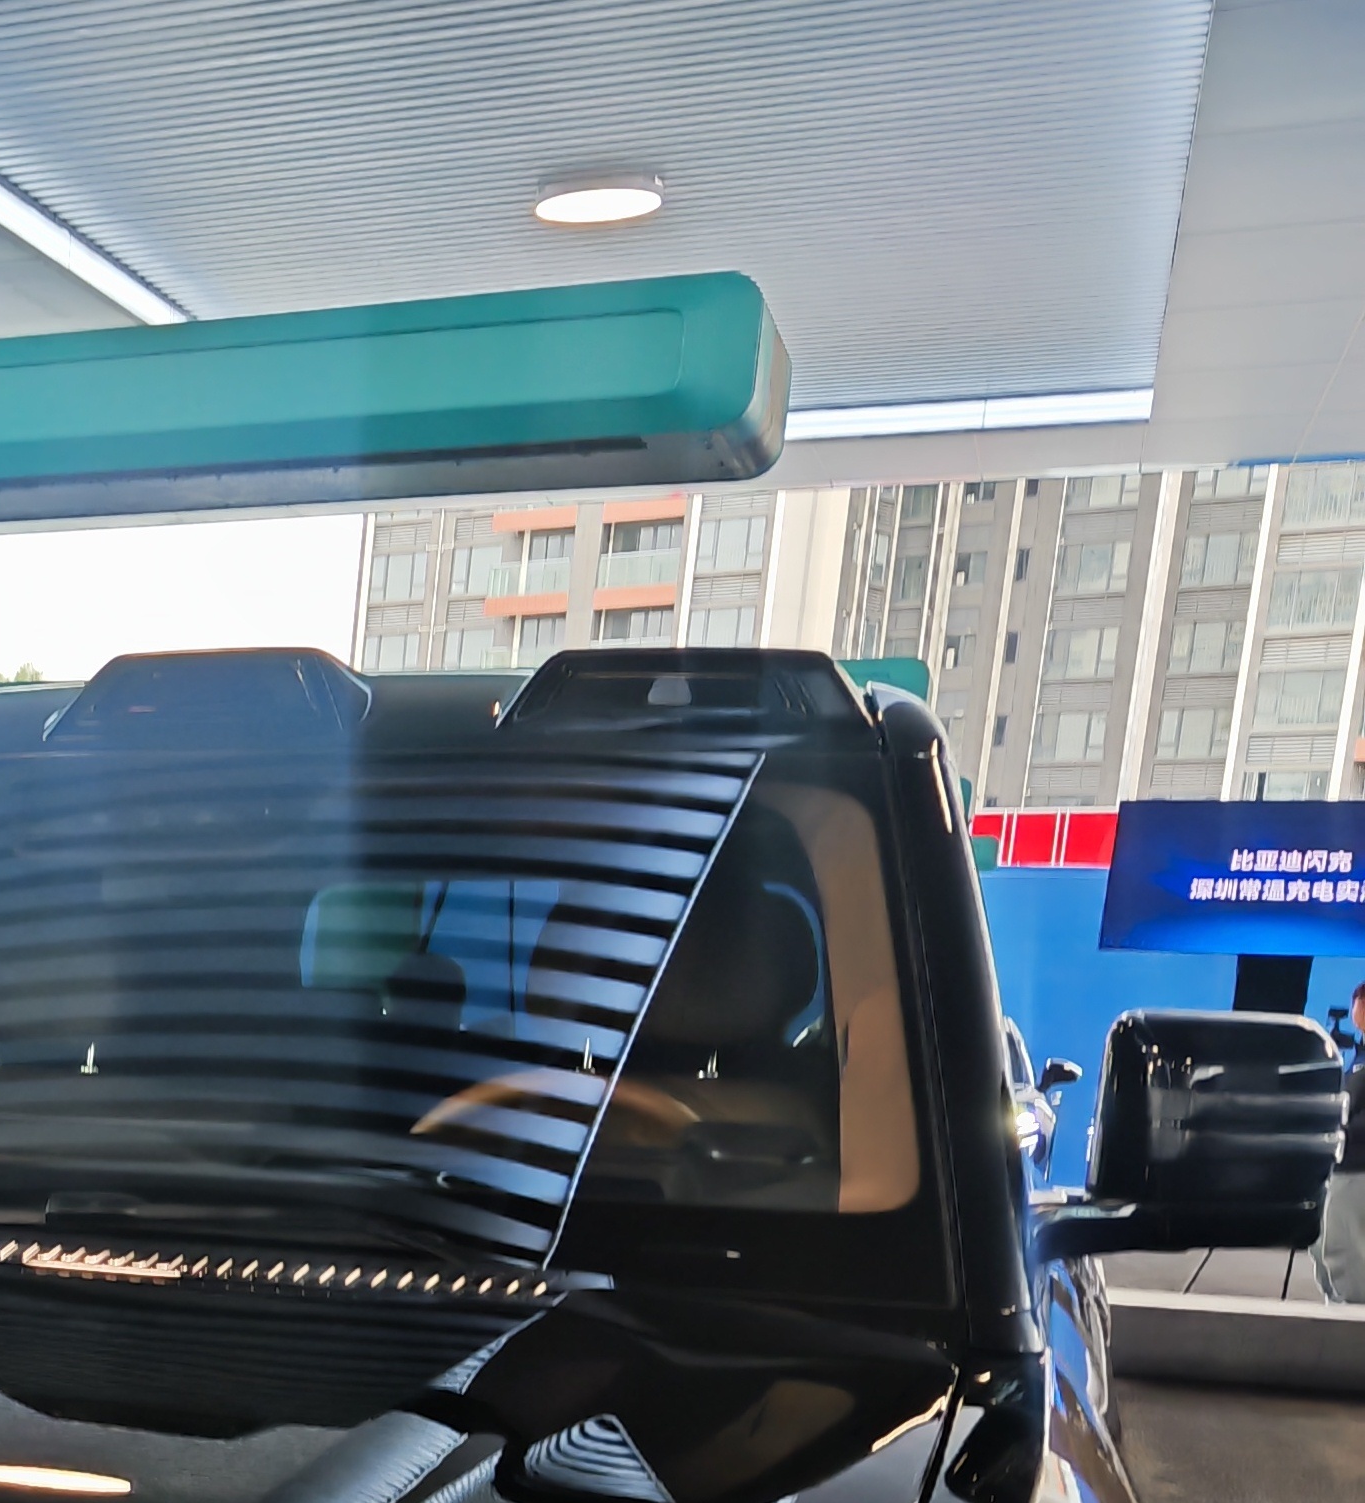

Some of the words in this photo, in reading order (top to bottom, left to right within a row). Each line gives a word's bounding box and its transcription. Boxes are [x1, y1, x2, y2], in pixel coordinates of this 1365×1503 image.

[1230, 848, 1353, 873] 比亚迪闪充
